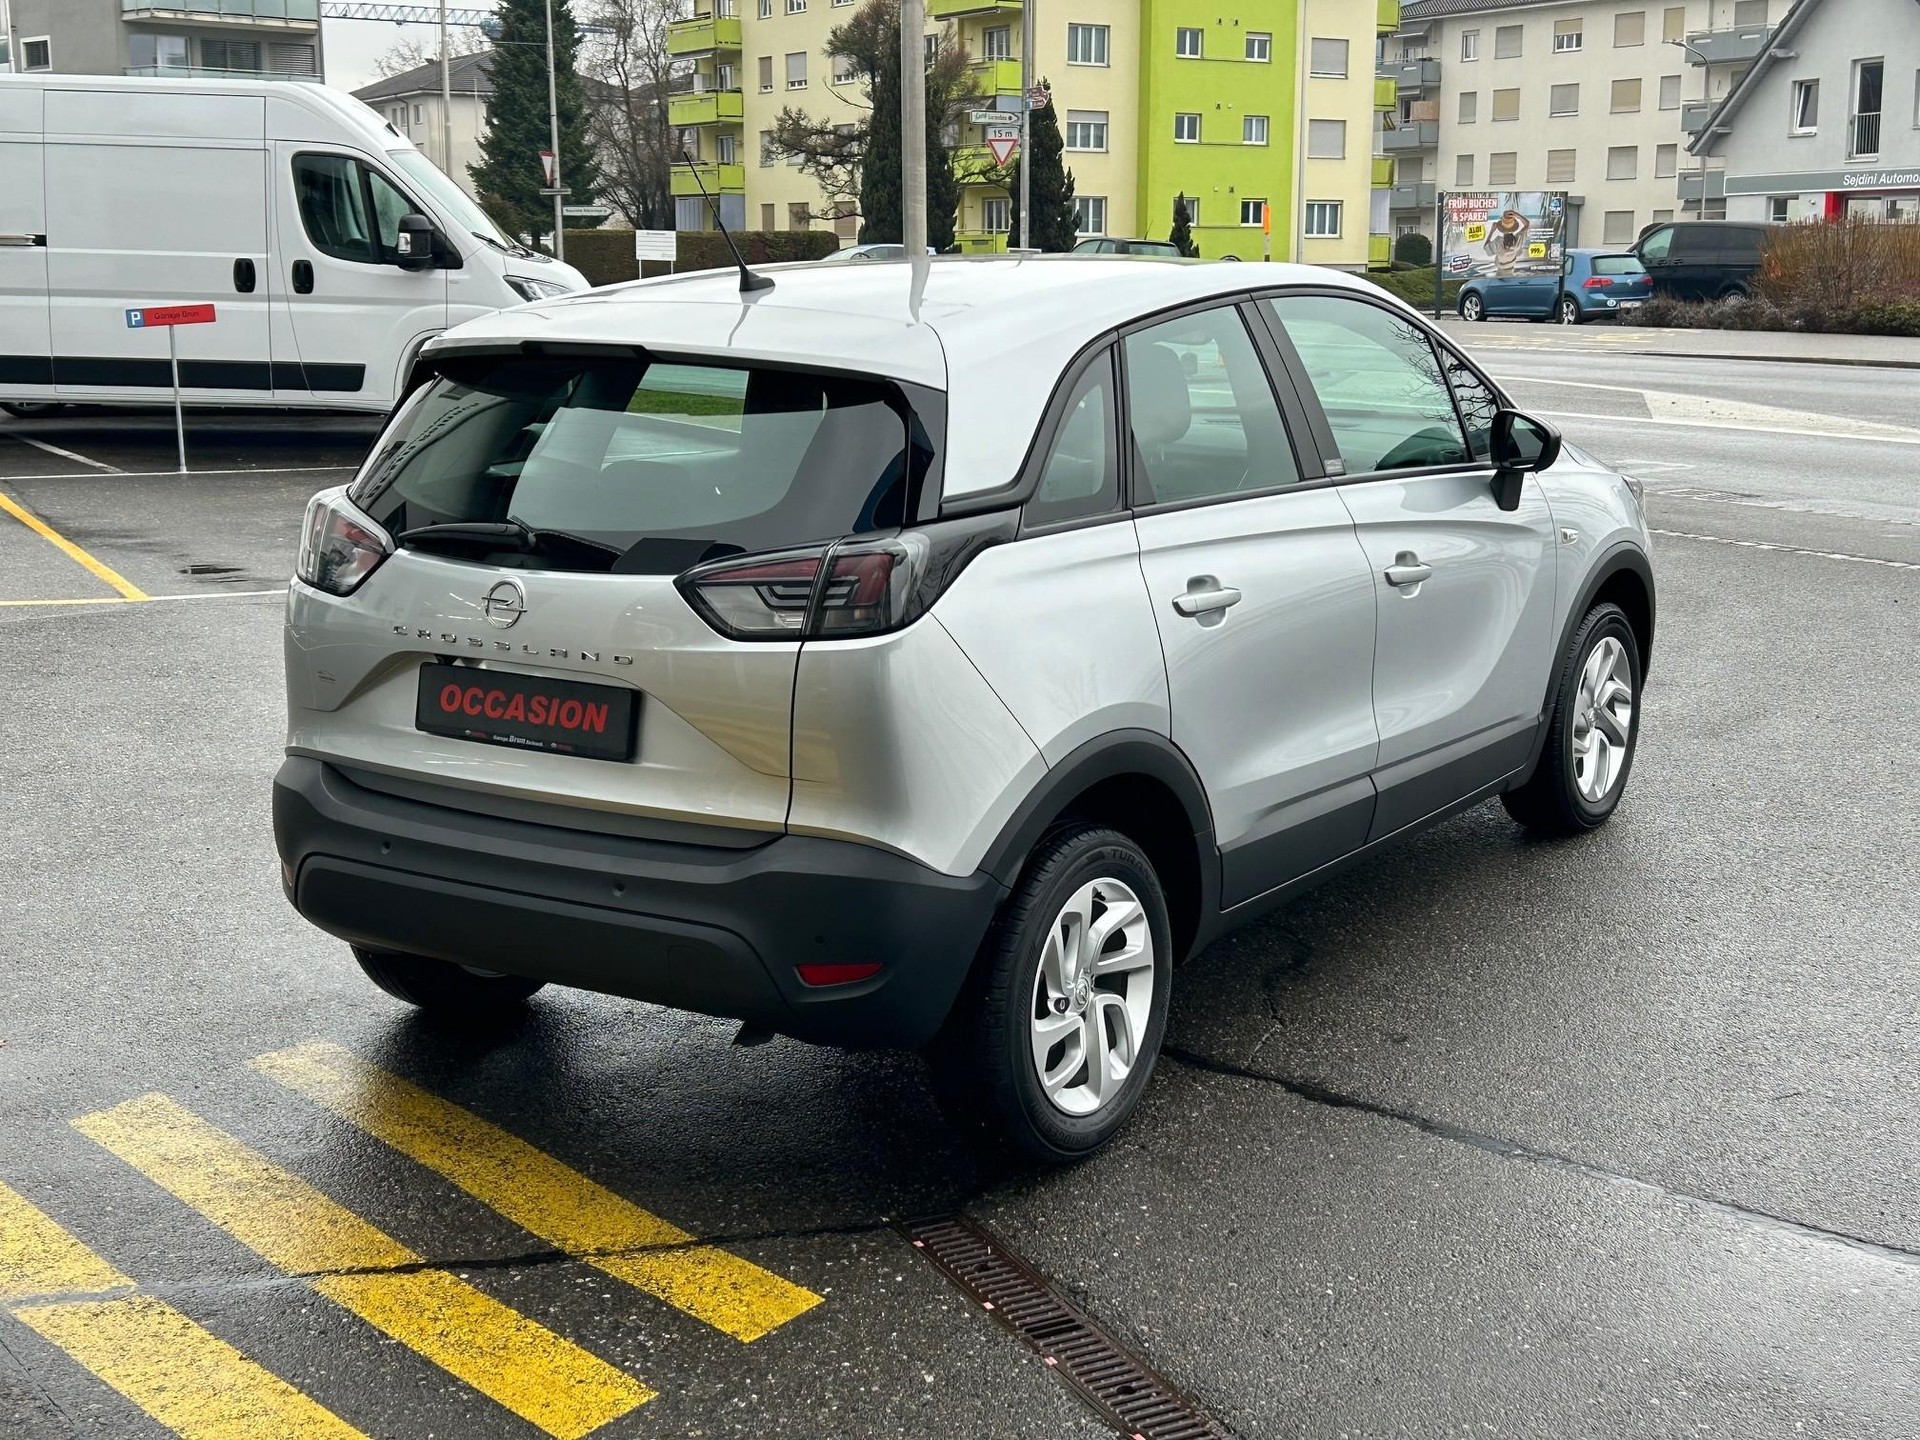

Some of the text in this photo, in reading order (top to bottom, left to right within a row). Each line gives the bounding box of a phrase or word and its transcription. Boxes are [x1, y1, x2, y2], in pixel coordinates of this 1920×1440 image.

[993, 130, 1002, 138] 15
[1843, 173, 1878, 187] Sejdini
[1448, 196, 1498, 209] FRÜH BUCHEN
[1452, 211, 1488, 222] & SPAREN
[1468, 225, 1482, 234] ALDI
[131, 312, 140, 325] P
[392, 625, 634, 666] CROSSLAND
[439, 683, 609, 734] OCCASION
